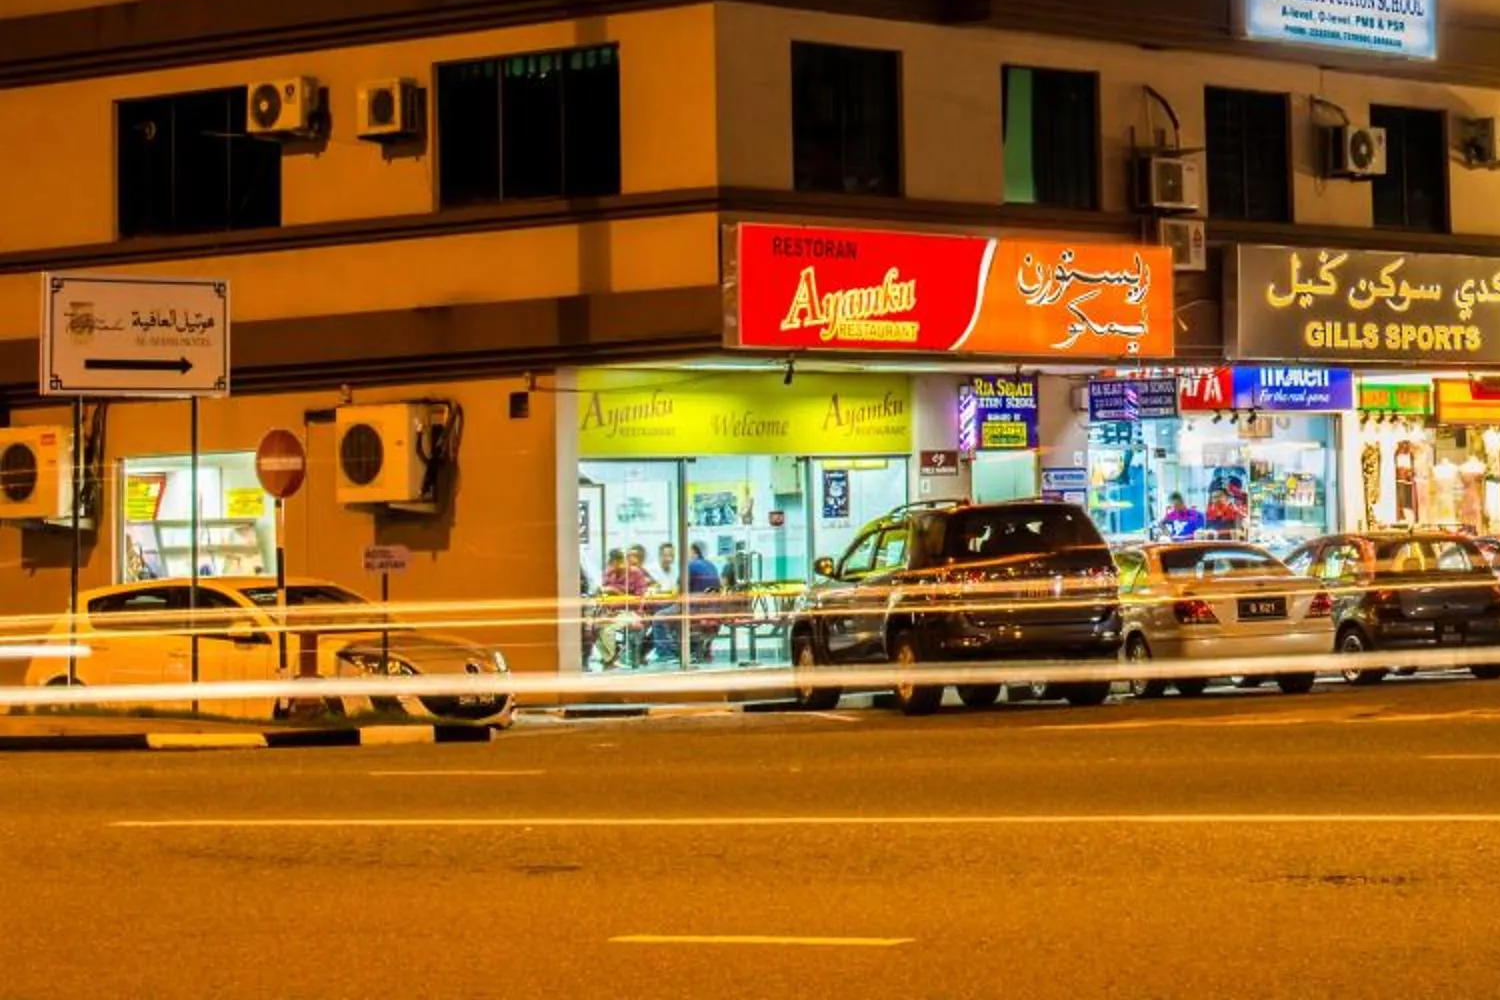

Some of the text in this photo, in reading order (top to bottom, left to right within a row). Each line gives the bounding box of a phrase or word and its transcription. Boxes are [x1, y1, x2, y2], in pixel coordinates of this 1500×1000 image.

[772, 236, 858, 260] RESTORAN
[1348, 257, 1442, 311] سوكن
[781, 266, 918, 340] Ayamku
[839, 321, 919, 340] RESTAURANT
[1304, 321, 1483, 352] GILLS SPORTS
[581, 390, 904, 438] Ayamku Ayamku
[711, 412, 790, 438] Welcome
